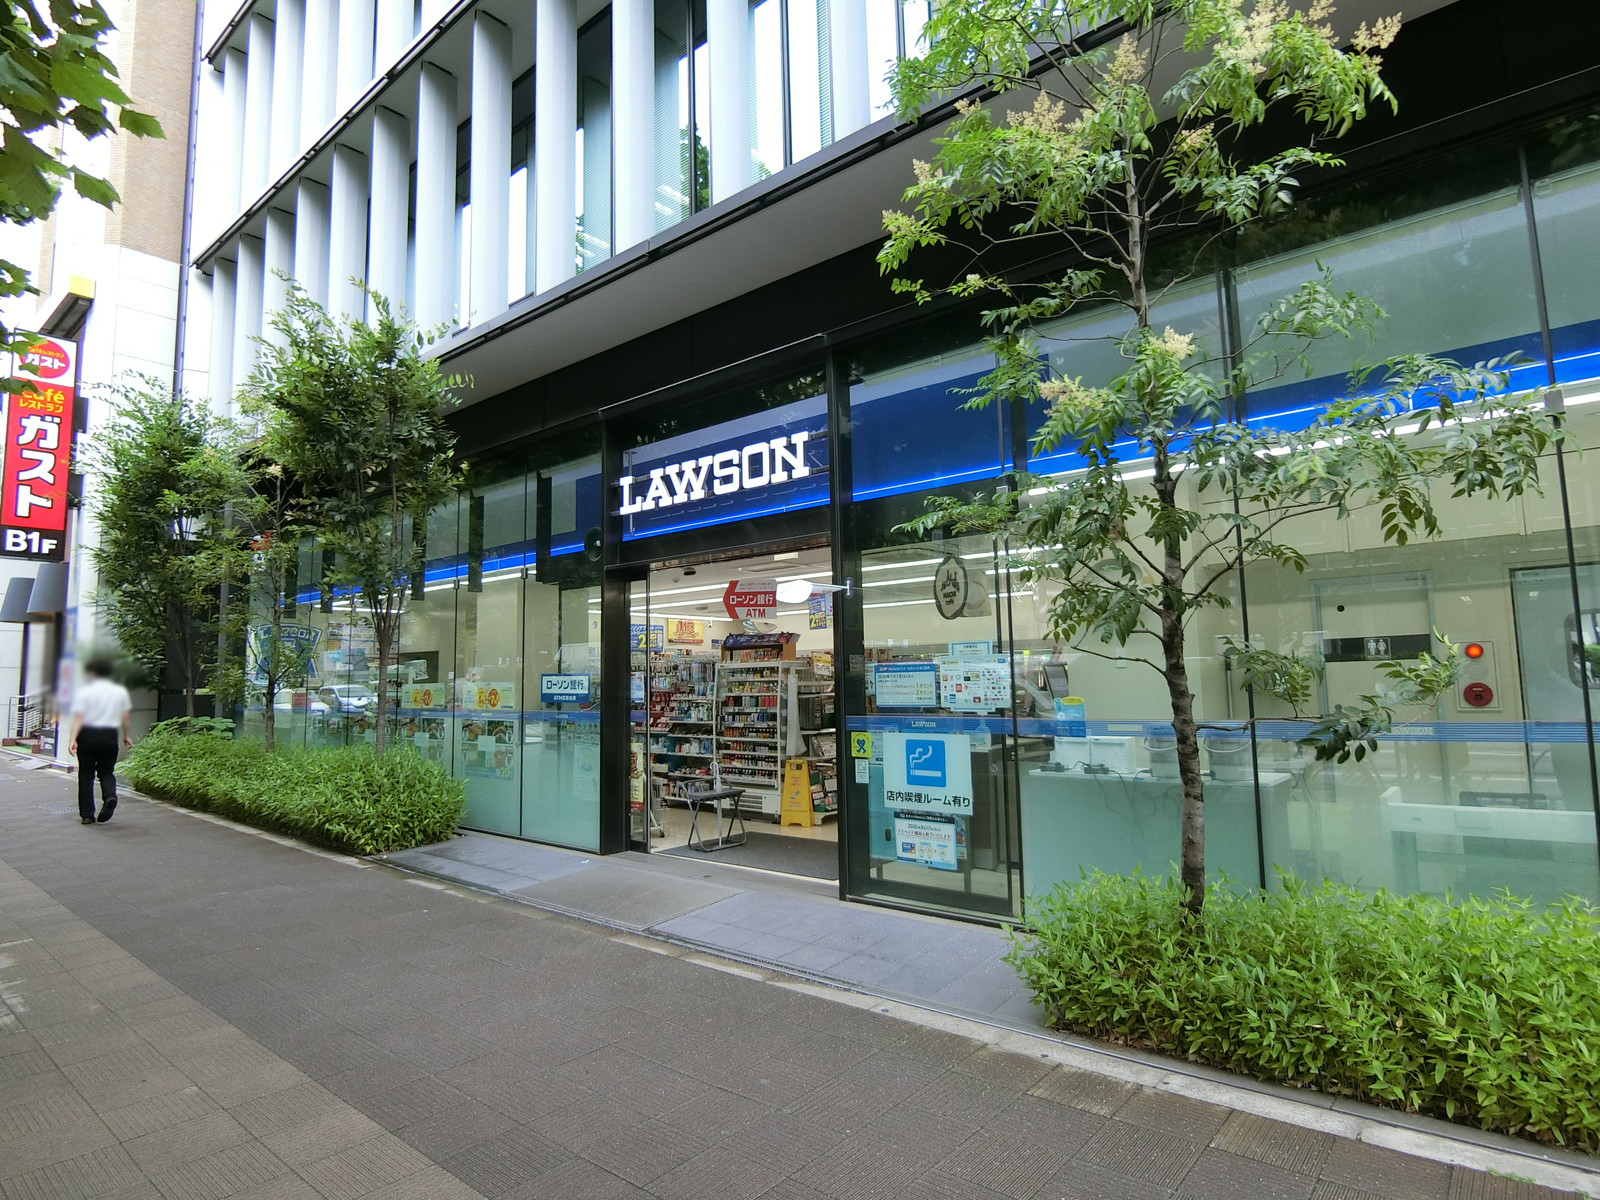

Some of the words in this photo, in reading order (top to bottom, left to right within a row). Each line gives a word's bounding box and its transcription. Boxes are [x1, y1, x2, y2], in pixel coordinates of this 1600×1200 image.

[26, 353, 66, 370] ガスト
[19, 399, 64, 413] レストラン
[16, 414, 62, 518] ガスト
[620, 431, 810, 515] LAWSON
[4, 529, 58, 554] B1F
[730, 594, 774, 605] ローソン銀行
[745, 608, 766, 618] ATM
[546, 680, 585, 690] ローソン銀行
[886, 790, 971, 808] 店内喫煙ルーム有り
